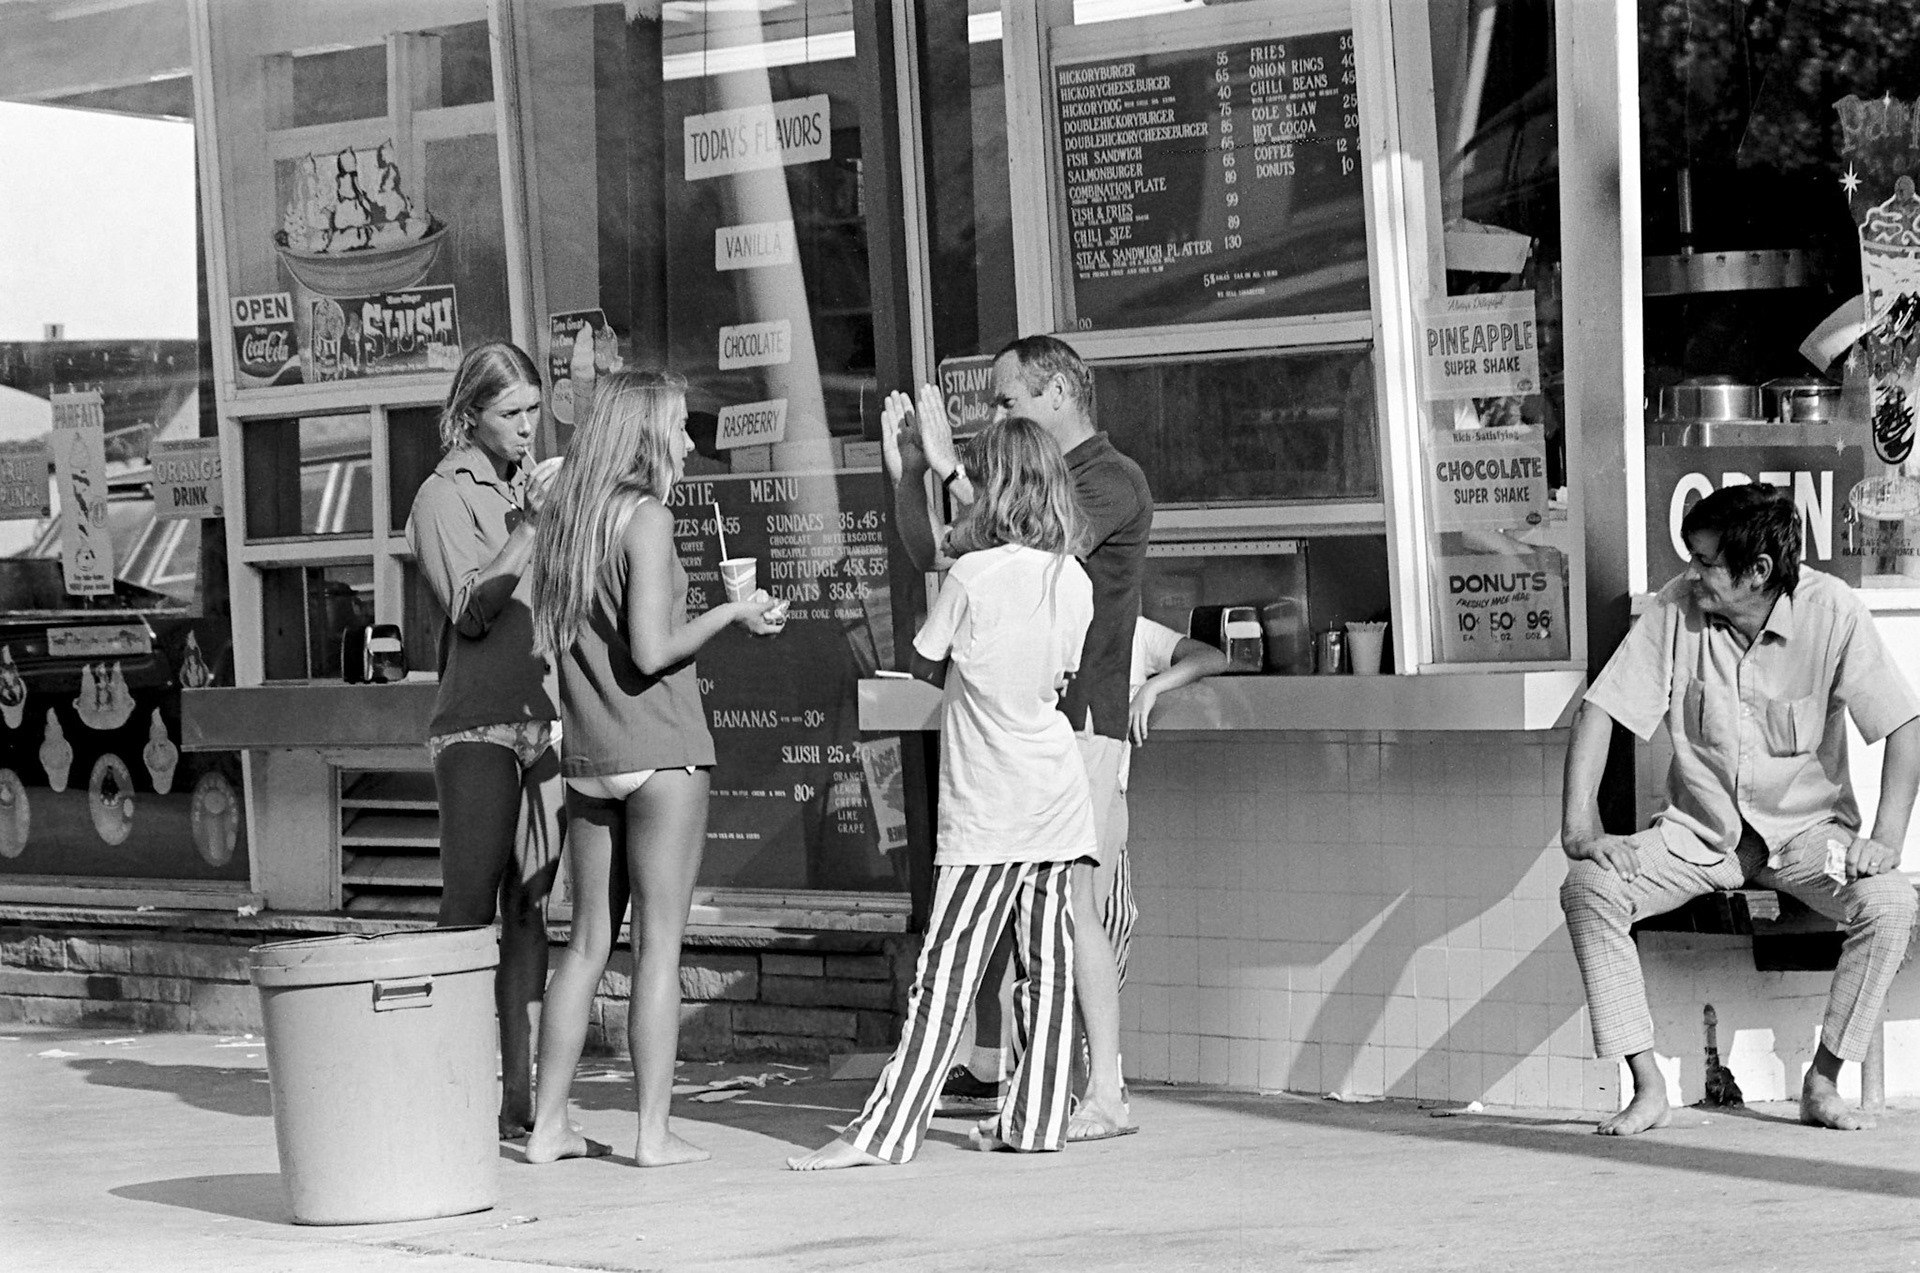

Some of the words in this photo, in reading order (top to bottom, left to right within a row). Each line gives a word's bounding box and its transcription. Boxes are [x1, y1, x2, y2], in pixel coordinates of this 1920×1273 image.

[1251, 44, 1285, 62] FRIES
[1059, 63, 1136, 85] HICKORYBURGER
[1216, 51, 1229, 66] 55
[1249, 61, 1286, 79] ONION
[1291, 57, 1324, 74] RINGS
[1061, 75, 1171, 102] HICKORYCHEESEBURGER
[1215, 68, 1229, 82] 65
[1251, 78, 1282, 96] CHILI
[1292, 73, 1328, 91] BEANS
[1062, 98, 1122, 118] HICKORYDOG
[1217, 85, 1231, 100] 40
[1252, 105, 1280, 121] COLE
[1285, 101, 1317, 118] SLAW
[1064, 109, 1175, 135] DOUBLEHICKORYBURGER
[1219, 102, 1232, 117] 75
[1253, 122, 1273, 140] HOT
[1280, 118, 1316, 136] COCOA
[1344, 114, 1359, 129] 20
[755, 112, 822, 154] FLAVORS
[1065, 121, 1208, 151] DOUBLEHICKORYCHEESEBURGER
[1221, 119, 1233, 134] 85
[1066, 152, 1089, 168] FISH
[1094, 146, 1142, 165] SANDWICH
[1254, 144, 1294, 161] COFFEE
[1068, 162, 1143, 184] SALMONBURGER
[1223, 152, 1235, 167] 65
[1256, 161, 1295, 179] DONUTS
[1341, 156, 1354, 176] 10
[1069, 181, 1132, 200] COMBINATION
[1134, 177, 1166, 194] PLATE
[1071, 206, 1094, 225] FISH
[1097, 205, 1104, 220] &
[1106, 203, 1133, 219] FRIES
[726, 233, 783, 260] VANILLA
[1073, 228, 1102, 245] CHILI
[1110, 225, 1132, 243] SIZE
[1076, 250, 1108, 269] STEAK
[1113, 244, 1163, 264] SANDWICH
[1167, 240, 1213, 259] PLATTER
[1224, 234, 1242, 250] 130
[236, 296, 289, 321] OPEN
[725, 333, 783, 359] CHOCOLATE
[1426, 320, 1534, 356] PINEAPPLE
[1444, 359, 1477, 377] SUPER
[1483, 356, 1520, 375] SHAKE
[947, 393, 990, 428] Shake
[722, 410, 781, 439] RASPBERRY
[155, 458, 223, 485] ORANGE
[1435, 457, 1543, 482] CHOCOLATE
[172, 486, 208, 507] DRINK
[667, 483, 716, 507] OSTIE
[750, 478, 799, 503] MENU
[1454, 488, 1489, 504] SUPER
[1494, 486, 1530, 503] SHAKE
[767, 513, 824, 533] SUNDAES
[1669, 470, 1834, 563] ON
[770, 534, 812, 546] CHOCOLATE
[823, 531, 883, 545] BUTTERSCOTCH
[770, 561, 795, 580] HOT
[797, 560, 839, 580] FUDGE
[771, 584, 821, 602] FLOATS
[1449, 571, 1547, 594] DONUTS
[811, 608, 831, 620] COKE
[713, 710, 778, 728] BANANAS
[781, 746, 821, 764] SLUSH
[794, 783, 815, 802] 80¢
[837, 811, 858, 821] LIME
[837, 822, 865, 834] GRAPE
